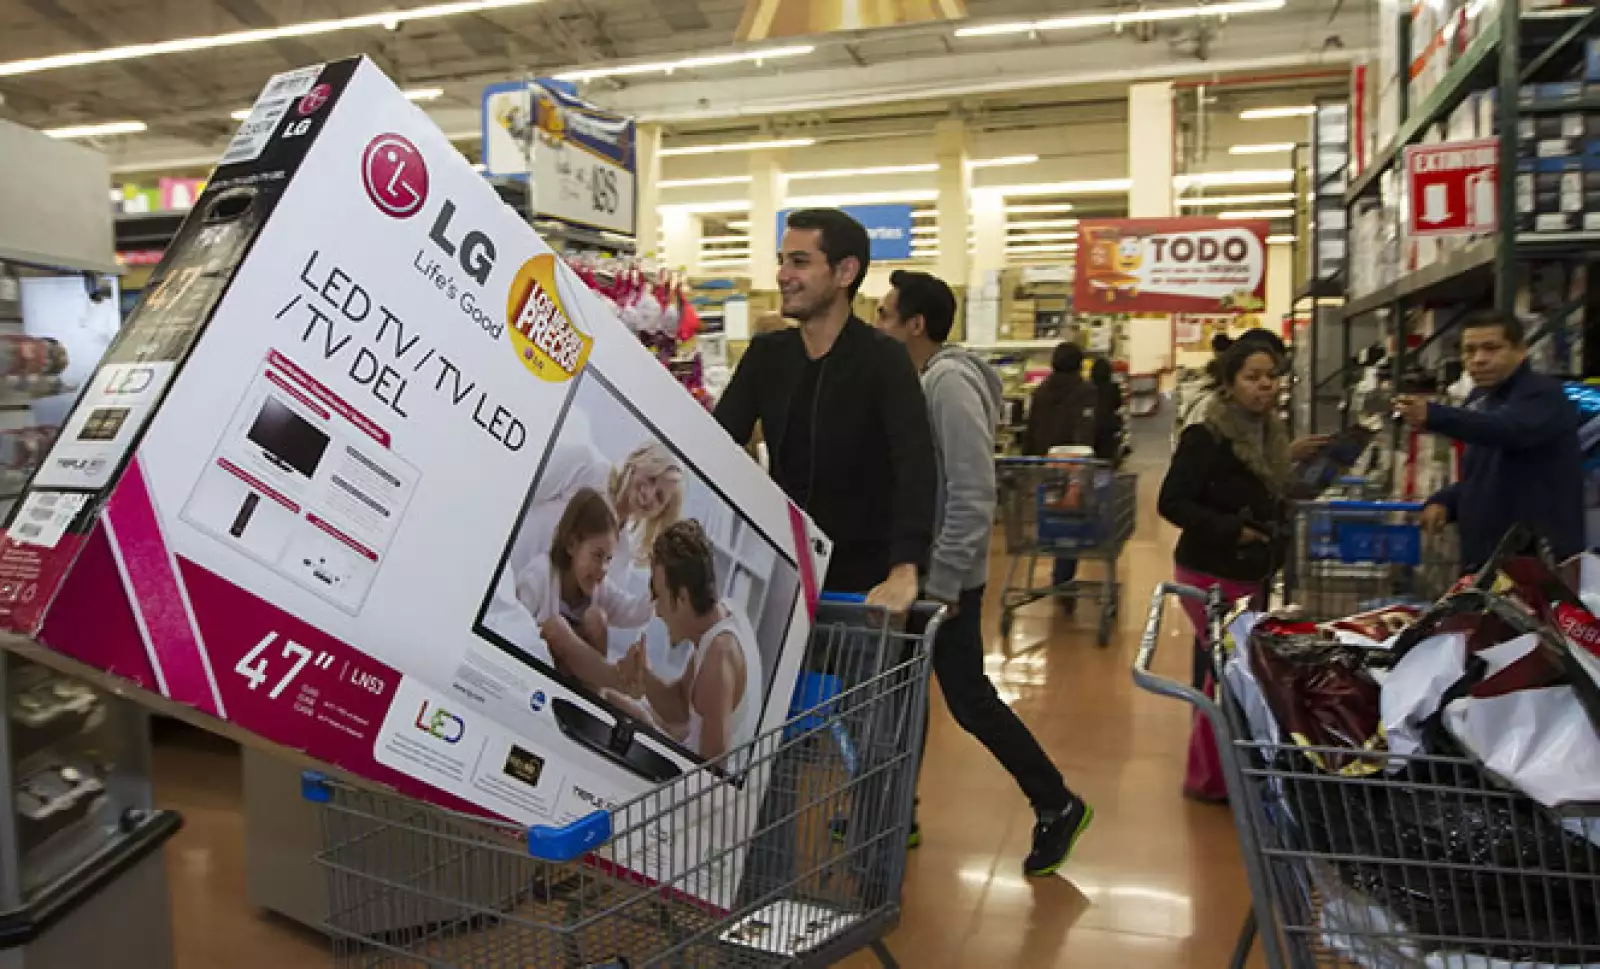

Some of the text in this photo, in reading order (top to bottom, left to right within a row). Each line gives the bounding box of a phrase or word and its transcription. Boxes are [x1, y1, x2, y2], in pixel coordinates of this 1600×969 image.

[282, 118, 311, 138] LG
[429, 198, 496, 286] LG
[1151, 236, 1248, 262] TODO
[414, 249, 459, 300] Life's
[460, 291, 504, 340] Good
[103, 367, 156, 394] LED
[300, 250, 371, 322] LED
[376, 305, 420, 359] TV
[435, 355, 475, 405] TV
[472, 392, 527, 452] LED
[301, 302, 353, 359] TV
[349, 346, 408, 418] DEL
[414, 699, 466, 744] LED
